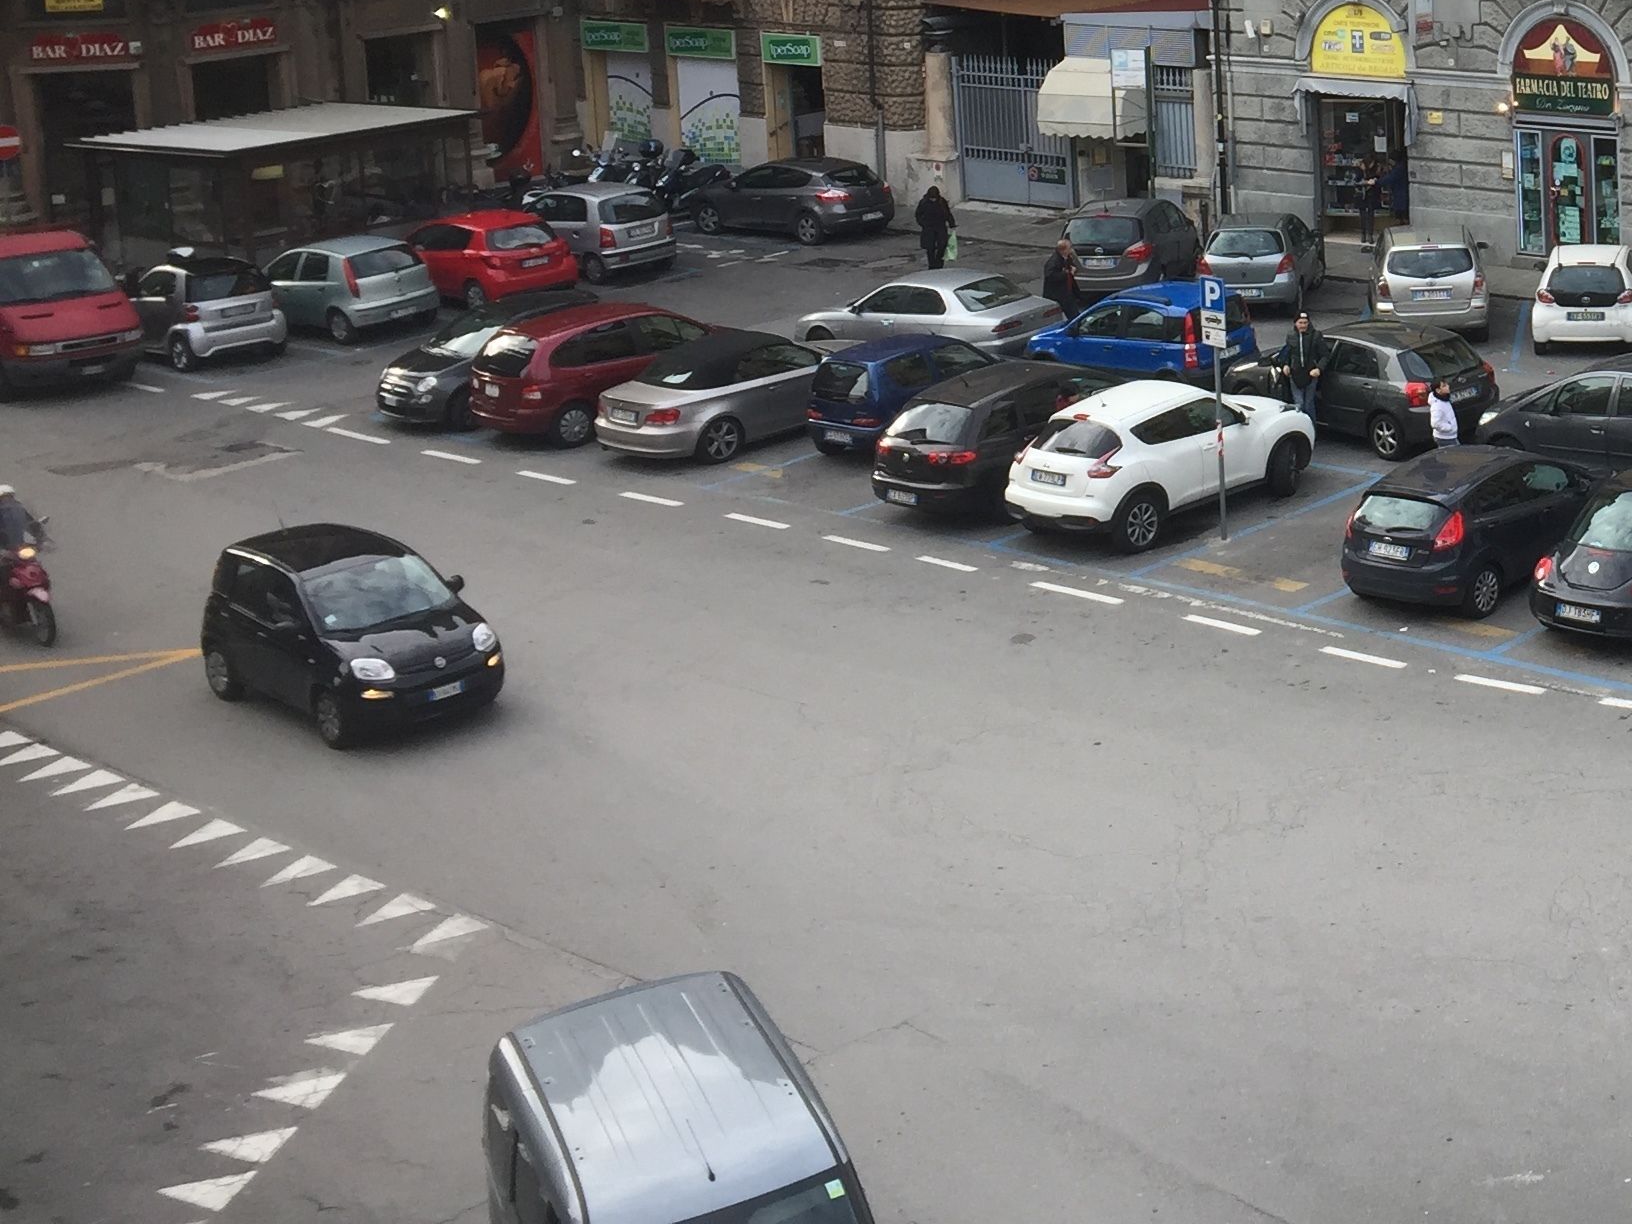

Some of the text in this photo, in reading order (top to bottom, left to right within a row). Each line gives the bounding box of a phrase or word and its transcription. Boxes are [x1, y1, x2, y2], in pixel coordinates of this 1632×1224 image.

[194, 26, 275, 49] BAR DIAZ
[585, 29, 621, 44] IperSoap
[670, 34, 707, 50] IperSoap
[32, 41, 124, 59] BAR DIAZ
[771, 43, 811, 58] IperSoap
[1516, 78, 1610, 100] FARMACIA DEL TEATRO
[1205, 280, 1221, 308] P
